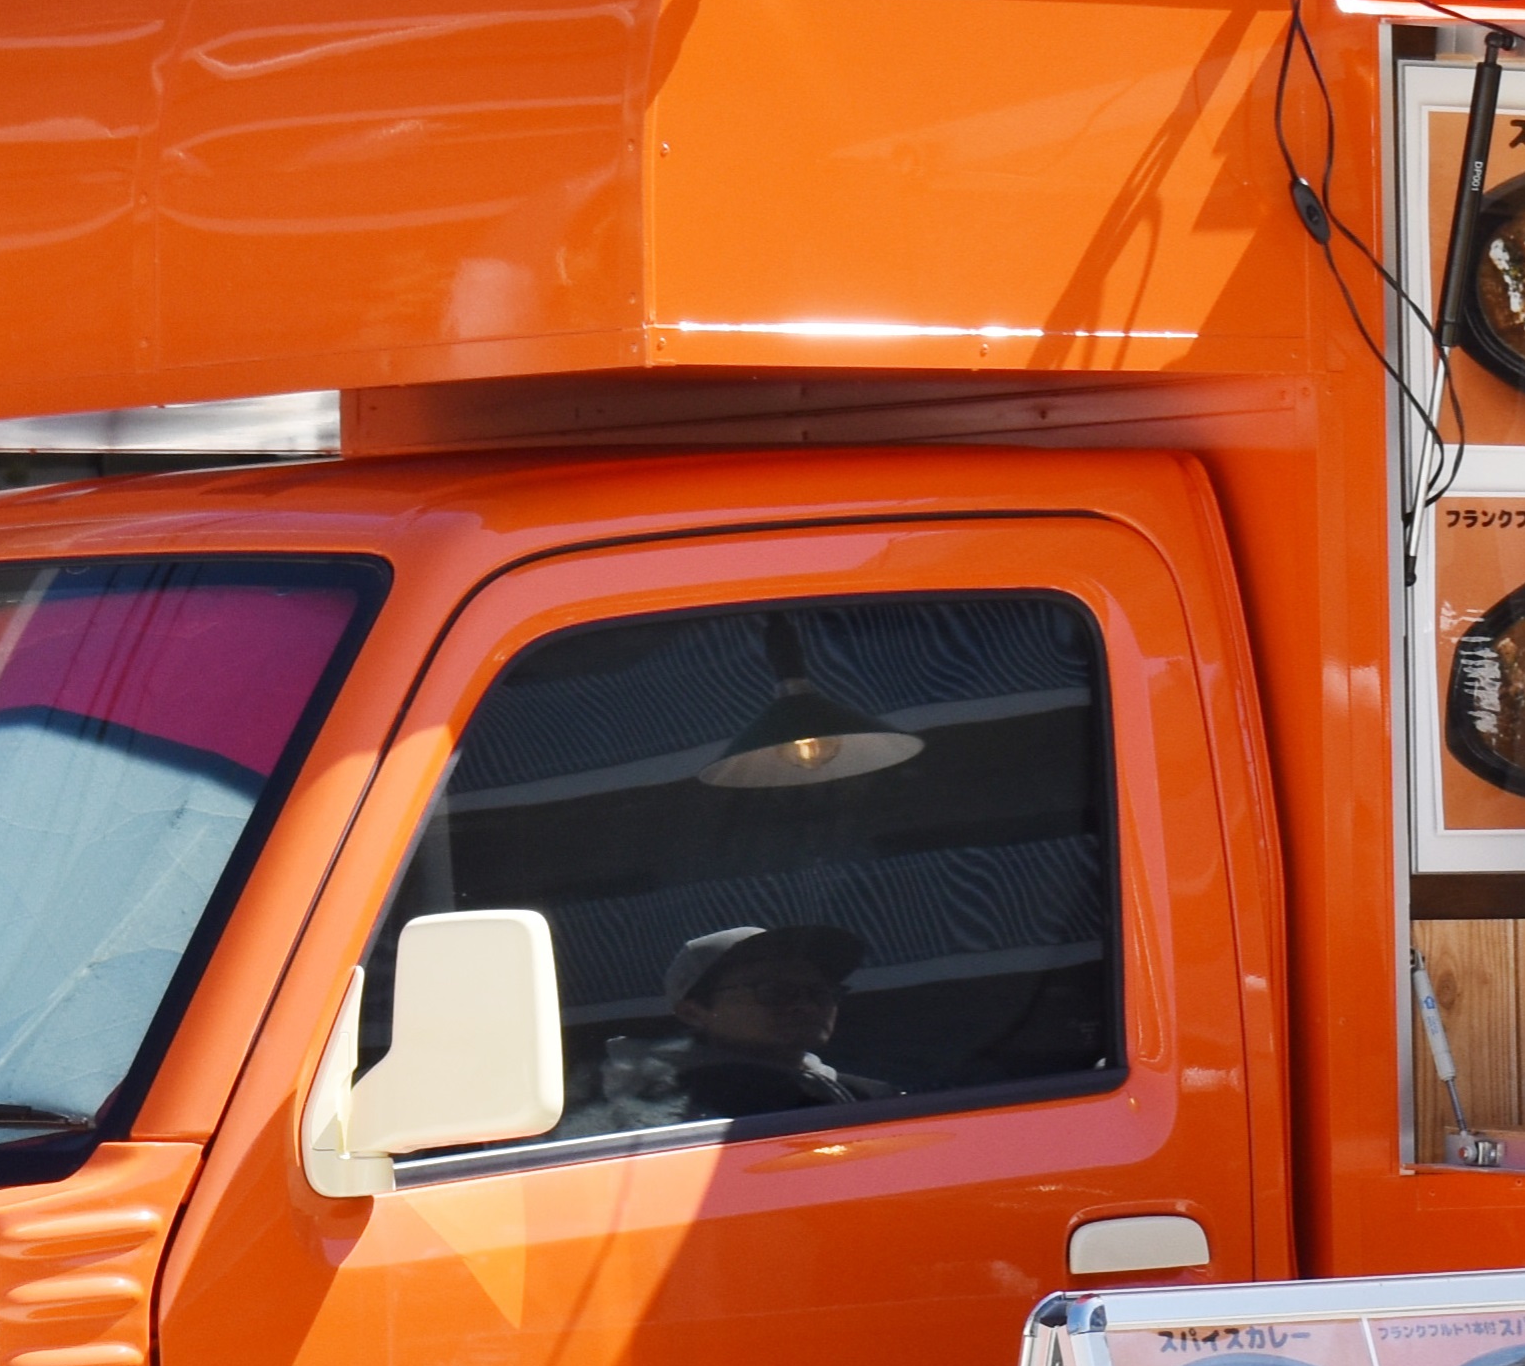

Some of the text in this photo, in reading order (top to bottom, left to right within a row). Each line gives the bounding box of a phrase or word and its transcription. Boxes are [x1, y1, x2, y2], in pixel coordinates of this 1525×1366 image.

[1158, 1326, 1311, 1352] スパイスカレー
